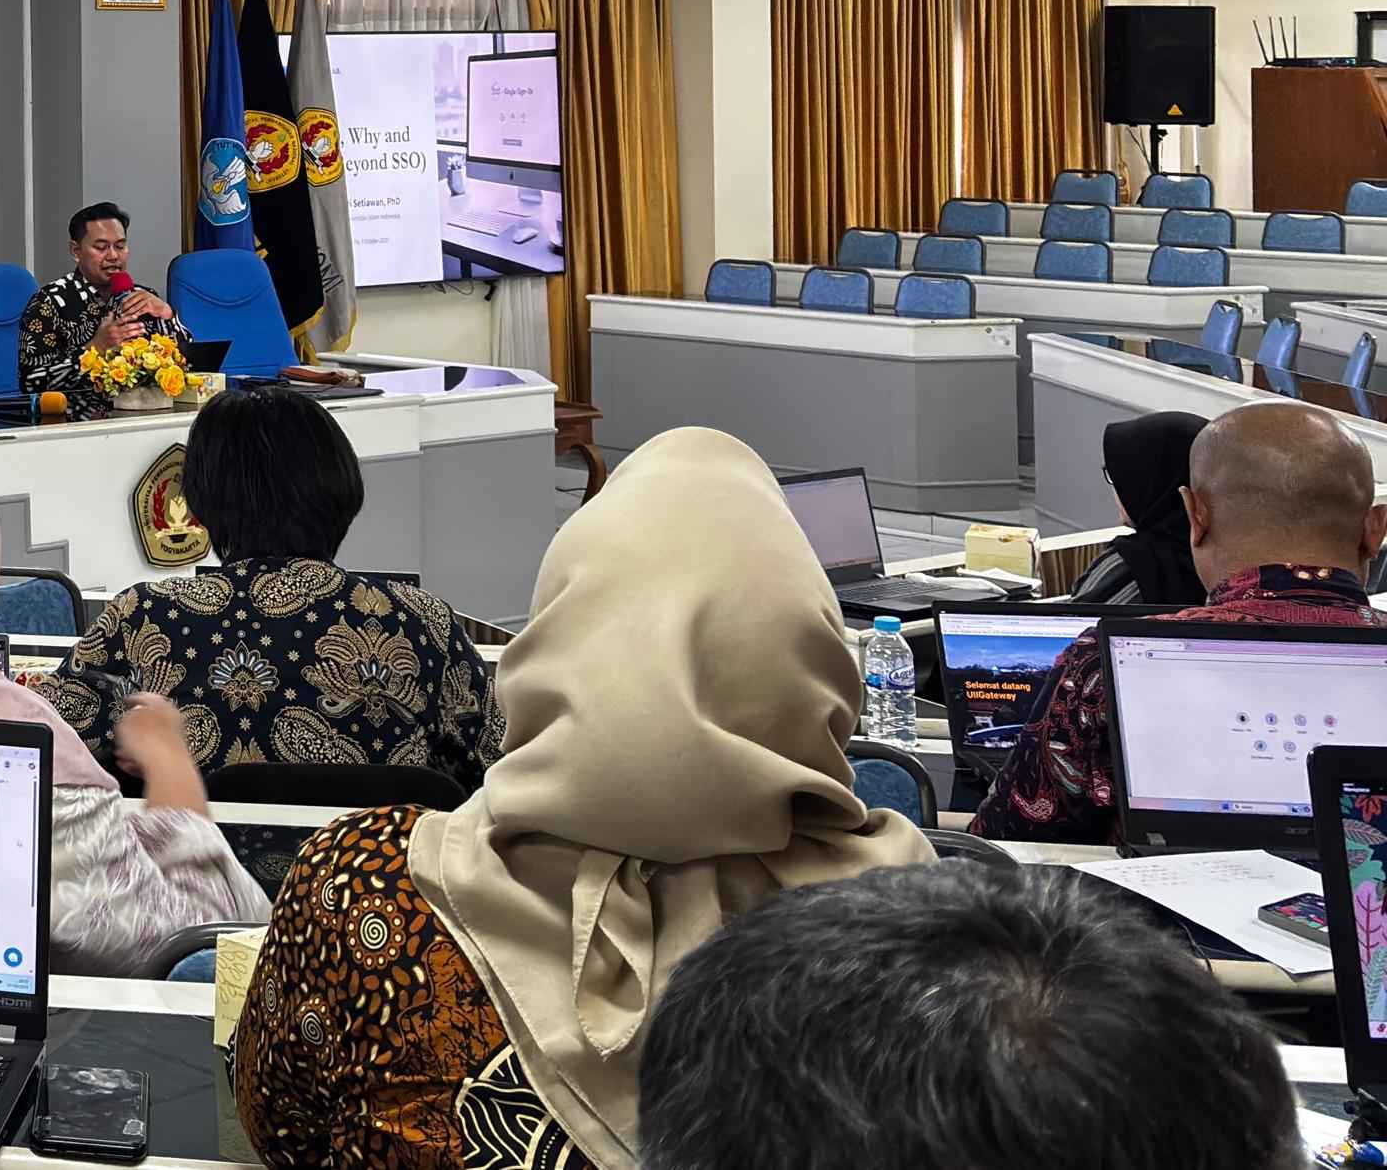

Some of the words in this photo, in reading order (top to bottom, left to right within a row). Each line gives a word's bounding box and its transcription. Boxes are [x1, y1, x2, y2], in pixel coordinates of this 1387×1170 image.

[347, 126, 380, 150] Why
[384, 125, 411, 143] and
[345, 152, 388, 177] eyond
[391, 150, 427, 175] SSO)
[353, 197, 386, 209] Setiawan,
[965, 681, 1000, 691] Selamat
[1001, 681, 1032, 692] datang
